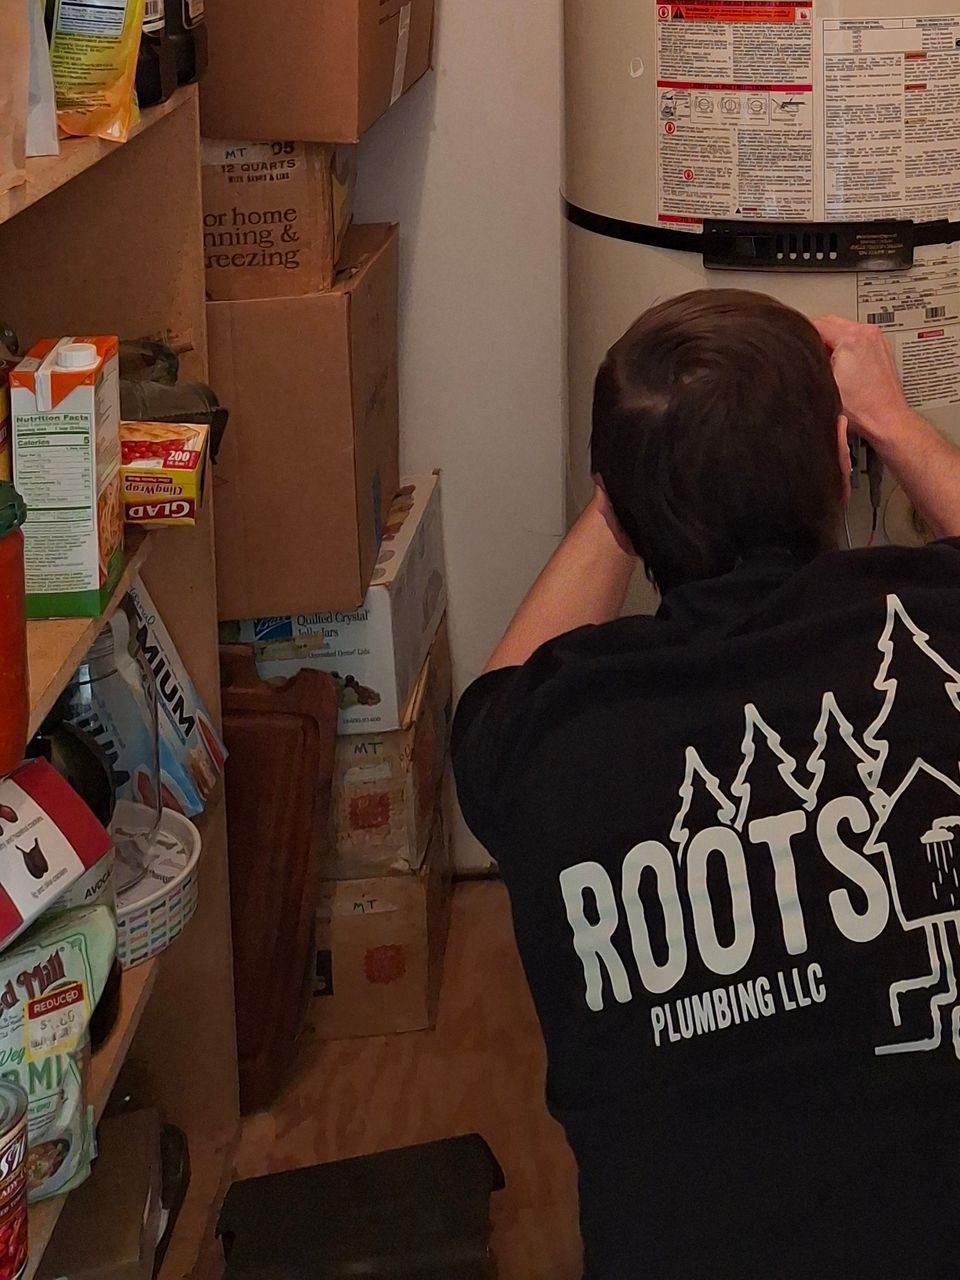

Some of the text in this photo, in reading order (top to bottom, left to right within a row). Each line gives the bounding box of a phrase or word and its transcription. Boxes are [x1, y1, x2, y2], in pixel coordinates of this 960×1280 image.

[225, 147, 248, 159] MT
[221, 159, 296, 173] 12 QUARTS
[202, 206, 298, 227] or home
[203, 223, 300, 248] nning &
[203, 249, 300, 270] reezing
[16, 415, 60, 423] Nutrition
[83, 436, 90, 445] 5
[167, 450, 190, 461] 200
[125, 482, 183, 496] ClingWrap
[128, 500, 190, 518] GLAD
[297, 609, 369, 626] Quilted Crystal
[136, 624, 197, 738] MIUM
[353, 741, 383, 755] MT
[353, 898, 378, 913] MT
[558, 794, 891, 1012] ROOTS
[16, 948, 67, 1001] Mill
[33, 989, 79, 1014] REDUCED
[650, 962, 827, 1046] PLUMBING LLC
[28, 1055, 64, 1095] MI
